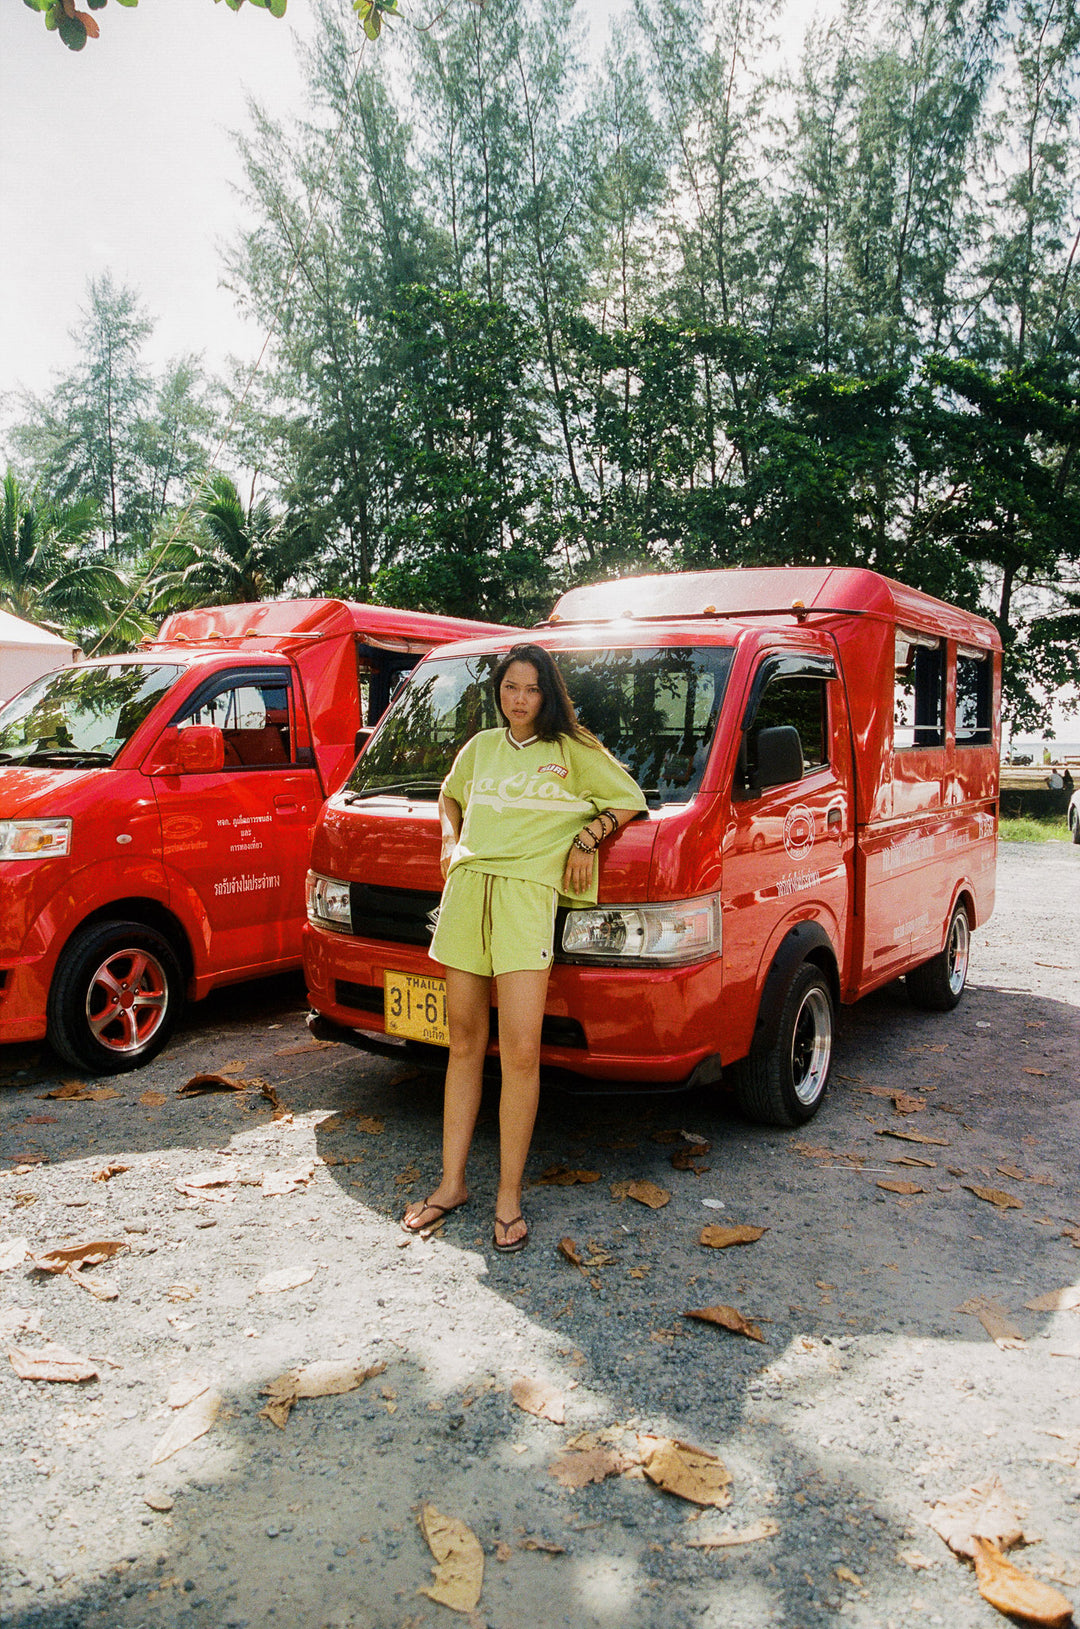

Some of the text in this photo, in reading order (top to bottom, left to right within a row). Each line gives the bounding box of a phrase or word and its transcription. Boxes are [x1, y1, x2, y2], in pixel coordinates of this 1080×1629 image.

[214, 872, 280, 896] รถรับจ้างไม่ประจำทาง
[406, 976, 445, 992] THAILA
[390, 986, 447, 1027] 31-61
